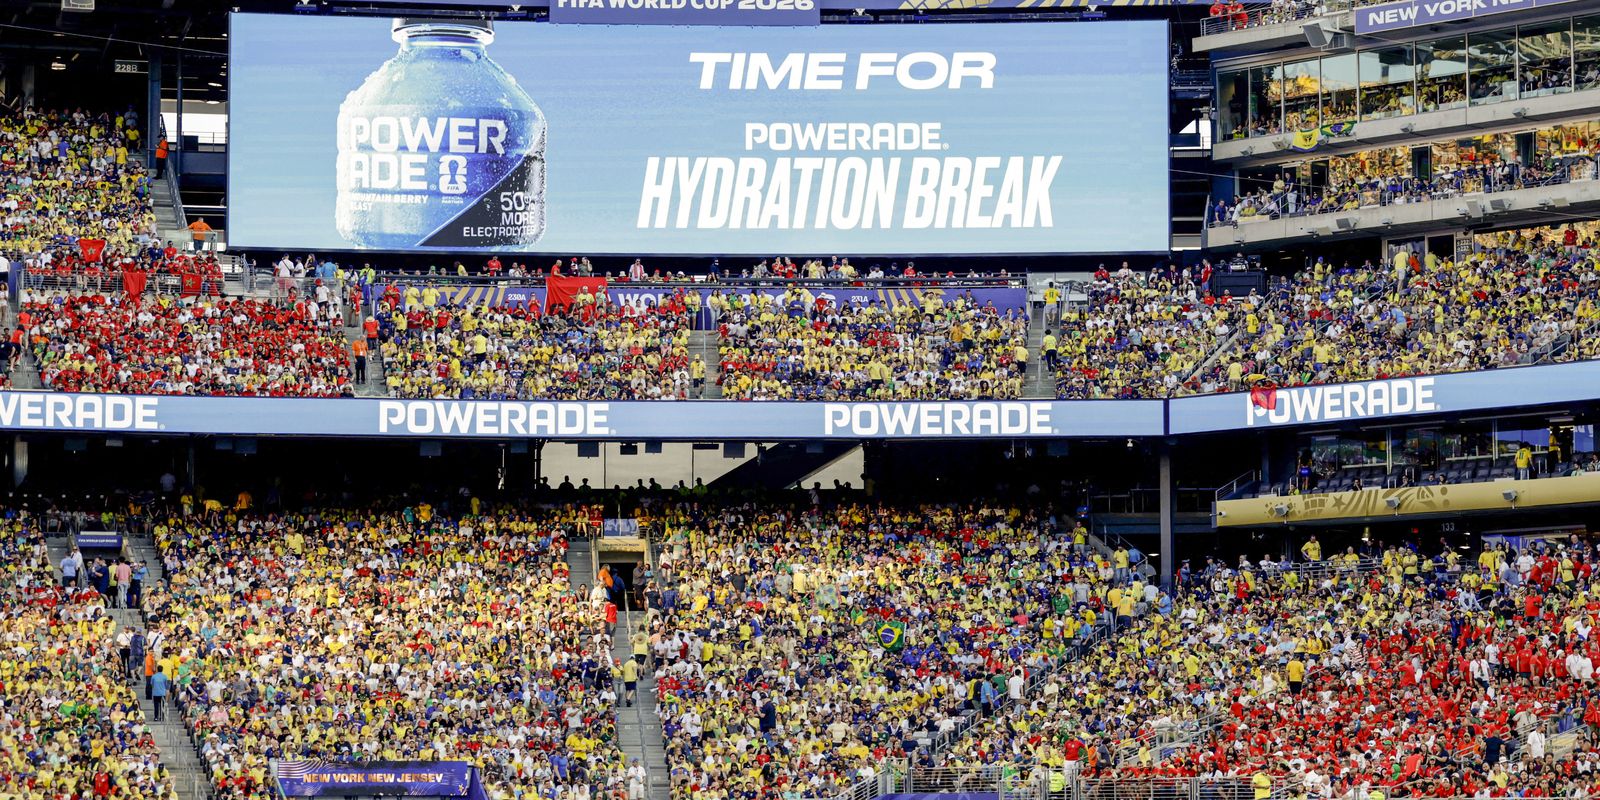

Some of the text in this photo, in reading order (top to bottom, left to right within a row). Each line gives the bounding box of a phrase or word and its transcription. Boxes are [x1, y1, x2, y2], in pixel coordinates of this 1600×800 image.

[1368, 6, 1419, 26] NEW
[115, 64, 138, 72] 228B
[688, 51, 997, 90] TIME FOR
[350, 117, 509, 155] POWER
[745, 122, 942, 151] POWERADE
[350, 154, 428, 190] ADE
[394, 194, 429, 204] BERRY
[636, 156, 1063, 230] HYDRATION BREAK
[501, 211, 535, 225] MORE
[379, 401, 609, 435] POWERADE
[824, 402, 1053, 435] POWERADE
[1441, 522, 1455, 531] 133
[303, 773, 443, 783] NEW YORK NEW JERSEY
